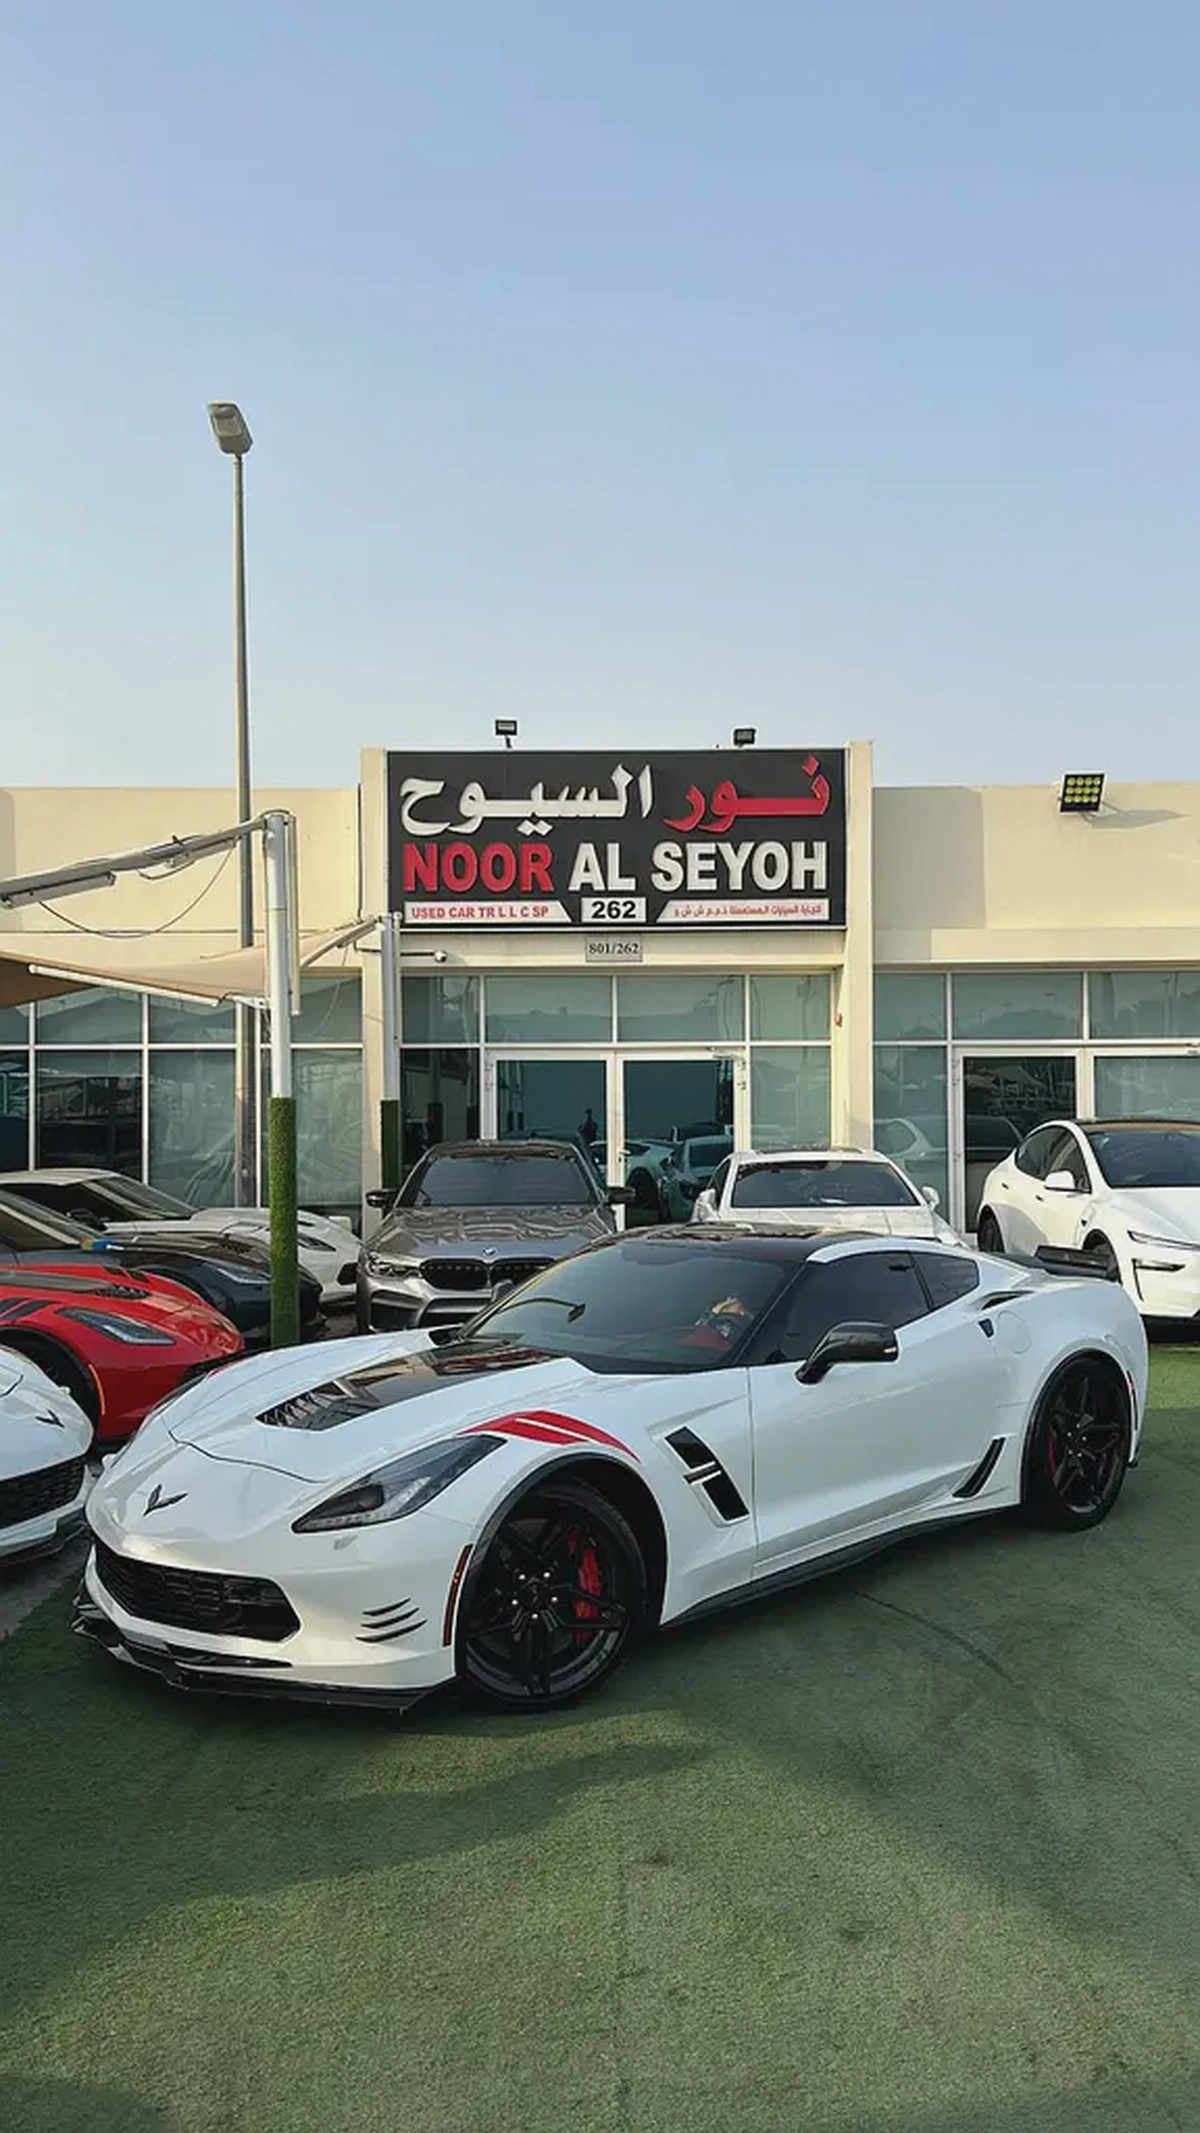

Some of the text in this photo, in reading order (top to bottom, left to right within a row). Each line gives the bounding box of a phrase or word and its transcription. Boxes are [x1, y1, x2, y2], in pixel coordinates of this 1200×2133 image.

[400, 755, 830, 837] نور السيوح
[403, 840, 828, 893] NOOR AL SEYOH
[411, 906, 549, 919] USED CAR TR L L C SP
[591, 901, 637, 919] 262
[589, 943, 639, 956] 801/262
